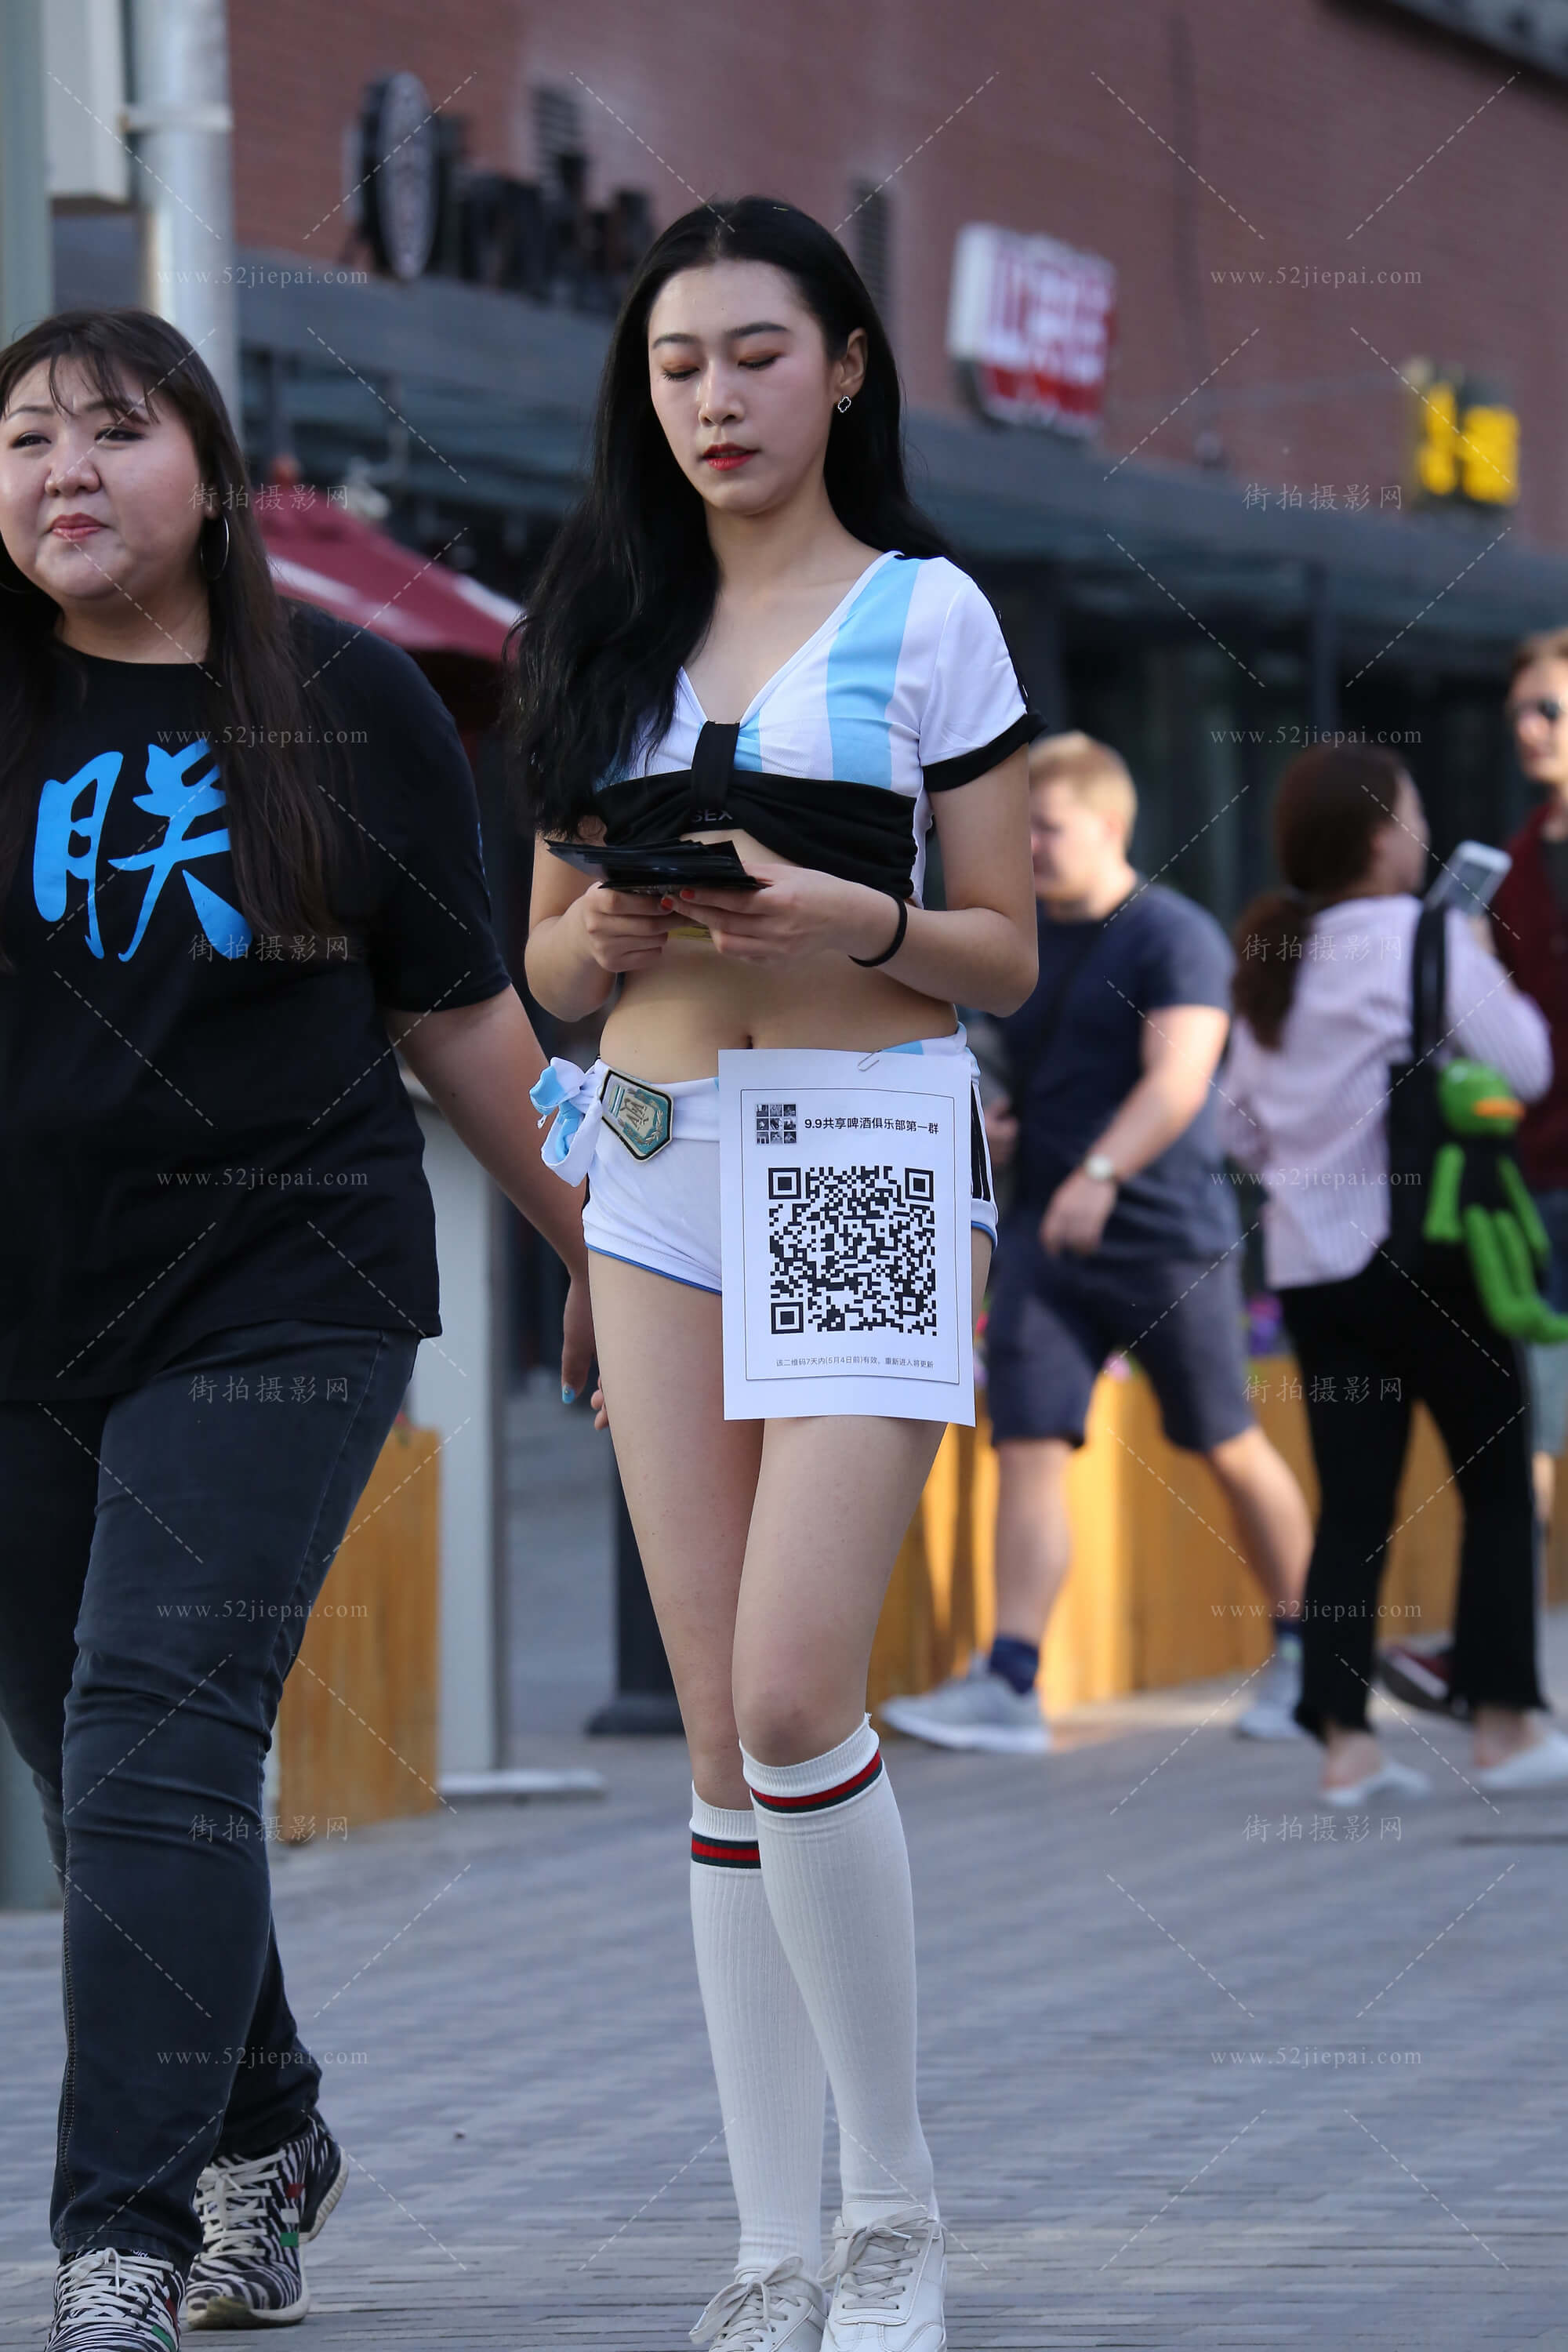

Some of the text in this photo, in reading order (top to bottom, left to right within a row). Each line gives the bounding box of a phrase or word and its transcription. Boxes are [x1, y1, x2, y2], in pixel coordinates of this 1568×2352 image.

[804, 1116, 939, 1134] 9.9共享啤酒俱乐部第一群
